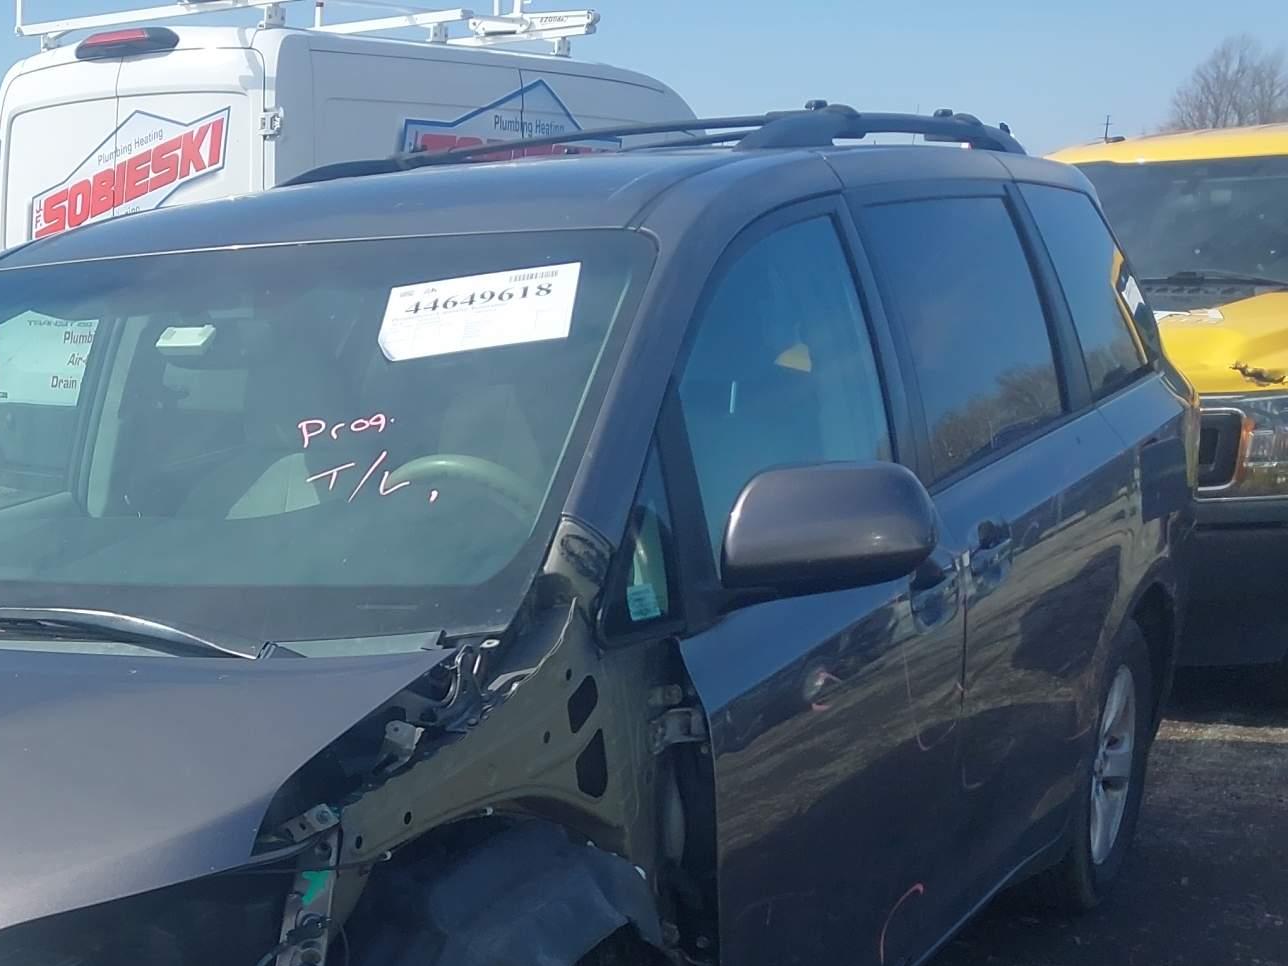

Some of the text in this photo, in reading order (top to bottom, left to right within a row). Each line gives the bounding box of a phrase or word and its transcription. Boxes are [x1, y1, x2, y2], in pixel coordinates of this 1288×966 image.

[97, 128, 164, 166] Plumbing Heating
[34, 117, 225, 239] SOBIESKI
[404, 282, 553, 315] 44649618
[50, 375, 77, 389] Drain
